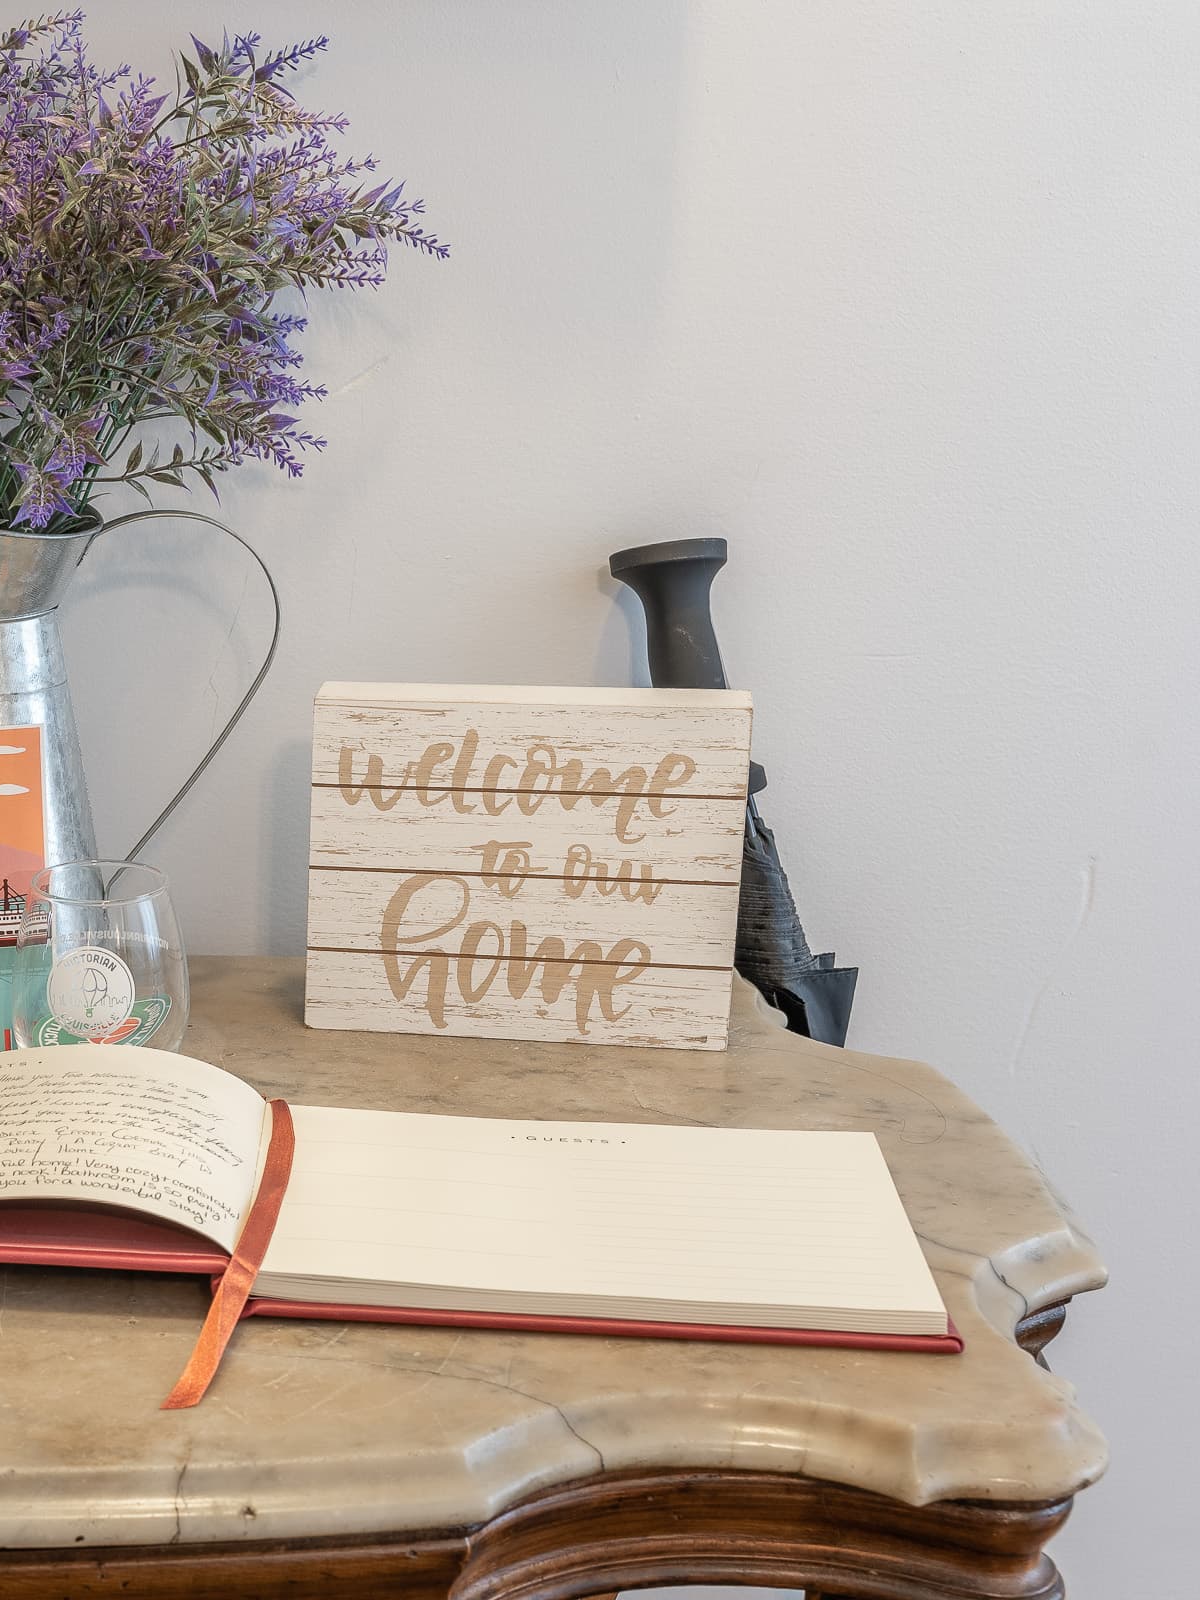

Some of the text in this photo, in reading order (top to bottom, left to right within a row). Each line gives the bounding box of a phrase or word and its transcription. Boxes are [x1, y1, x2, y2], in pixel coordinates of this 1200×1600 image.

[338, 729, 697, 844] welcome
[471, 840, 670, 905] to our
[381, 873, 652, 1035] home
[60, 1166, 136, 1184] Bathroom
[143, 1181, 157, 1191] is
[163, 1184, 183, 1198] so
[80, 1177, 163, 1201] wonderful
[85, 1159, 120, 1174] Very
[125, 1165, 160, 1183] cozy
